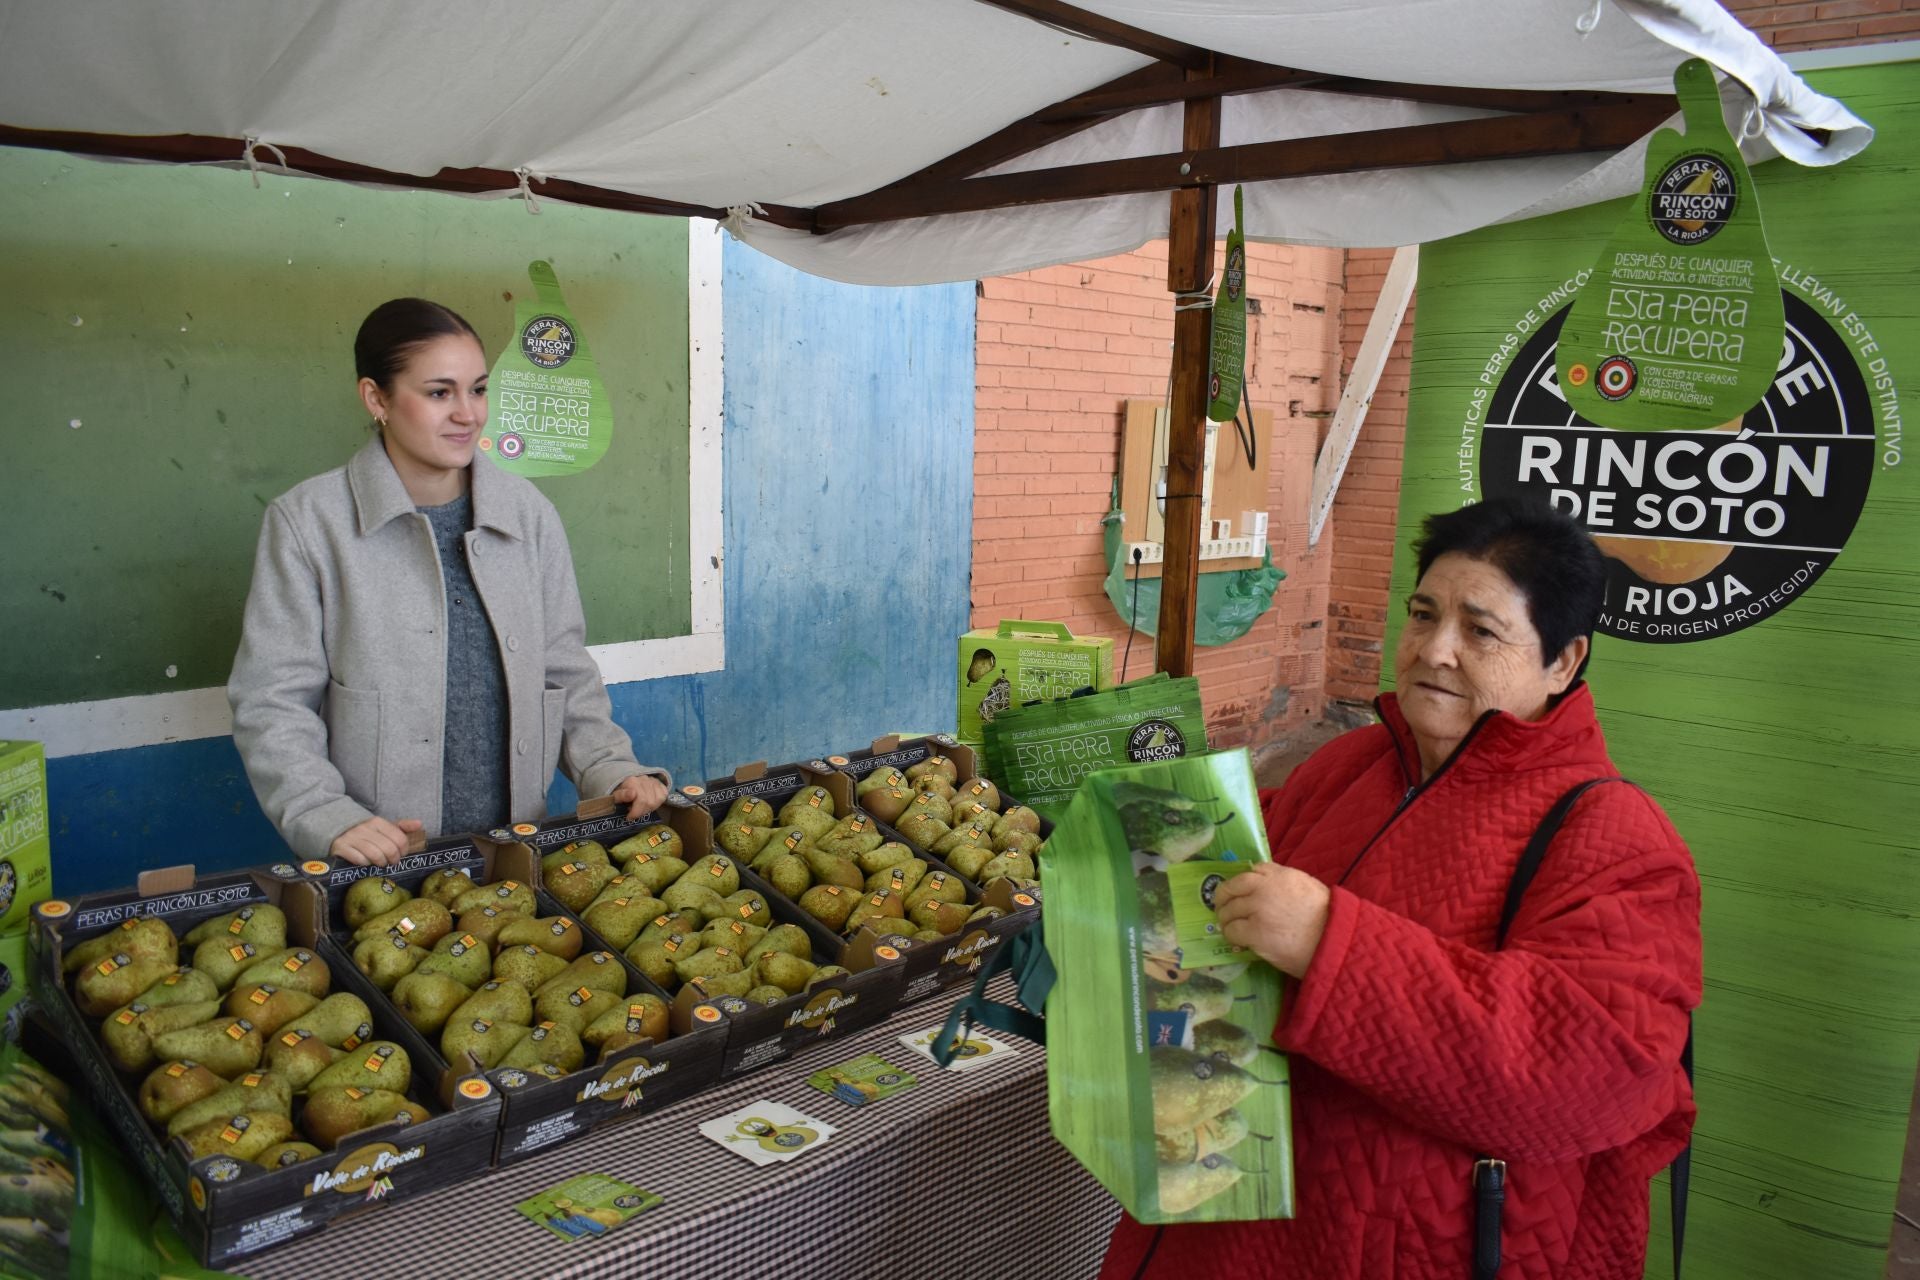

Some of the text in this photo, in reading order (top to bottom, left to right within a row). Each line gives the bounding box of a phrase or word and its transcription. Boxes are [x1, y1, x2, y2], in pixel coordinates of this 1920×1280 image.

[1666, 162, 1728, 189] PERAS DE
[1660, 193, 1728, 210] RINCÓN
[1665, 208, 1718, 220] DE SOTO
[1668, 226, 1709, 240] LA RIOJA
[1615, 252, 1666, 269] DESPUÉS
[1669, 256, 1686, 270] DE
[1688, 257, 1755, 276] CUALQUIER
[1612, 268, 1656, 281] ACTIVIDAD
[1656, 270, 1686, 283] FÍSICA
[1698, 273, 1754, 289] INTELECTUAL
[530, 321, 570, 338] PERAS DE
[544, 347, 565, 356] SOTO
[501, 369, 536, 382] DESPUÉS
[537, 374, 549, 382] DE
[1643, 365, 1661, 377] CON
[1781, 264, 1902, 471] LLEVAN ESTE DISTINTIVO.
[1457, 268, 1593, 493] AUTÉNTICAS PERAS DE RINCÓ
[1517, 427, 1830, 497] RINCÓN
[1550, 488, 1786, 538] DE SOTO
[1616, 618, 1641, 634] DE
[1646, 617, 1719, 636] ORIGEN
[1722, 559, 1821, 627] PROTEGIDA
[1624, 574, 1753, 616] RIOJA
[1111, 714, 1133, 725] FÍSICA
[1141, 705, 1184, 718] INTELECTUAL
[1133, 725, 1175, 746] PERAS DE
[1134, 742, 1180, 760] RINCÓN
[726, 788, 737, 799] DE
[737, 782, 766, 797] RINCÓN
[766, 780, 777, 790] DE
[777, 776, 797, 788] SOTO
[536, 829, 566, 844] PERAS
[567, 826, 581, 839] DE
[581, 817, 615, 835] RINCÓN
[331, 867, 368, 883] PERAS
[369, 865, 384, 877] DE
[428, 854, 443, 865] DE
[444, 849, 471, 862] SOTO
[77, 886, 250, 927] PERAS DE RINCÓN DE SOTO
[945, 947, 964, 962] Valle
[789, 994, 856, 1025] Valle de Rincón
[583, 1062, 667, 1099] Valle de Rincón
[312, 1147, 421, 1193] Valle de Rincón
